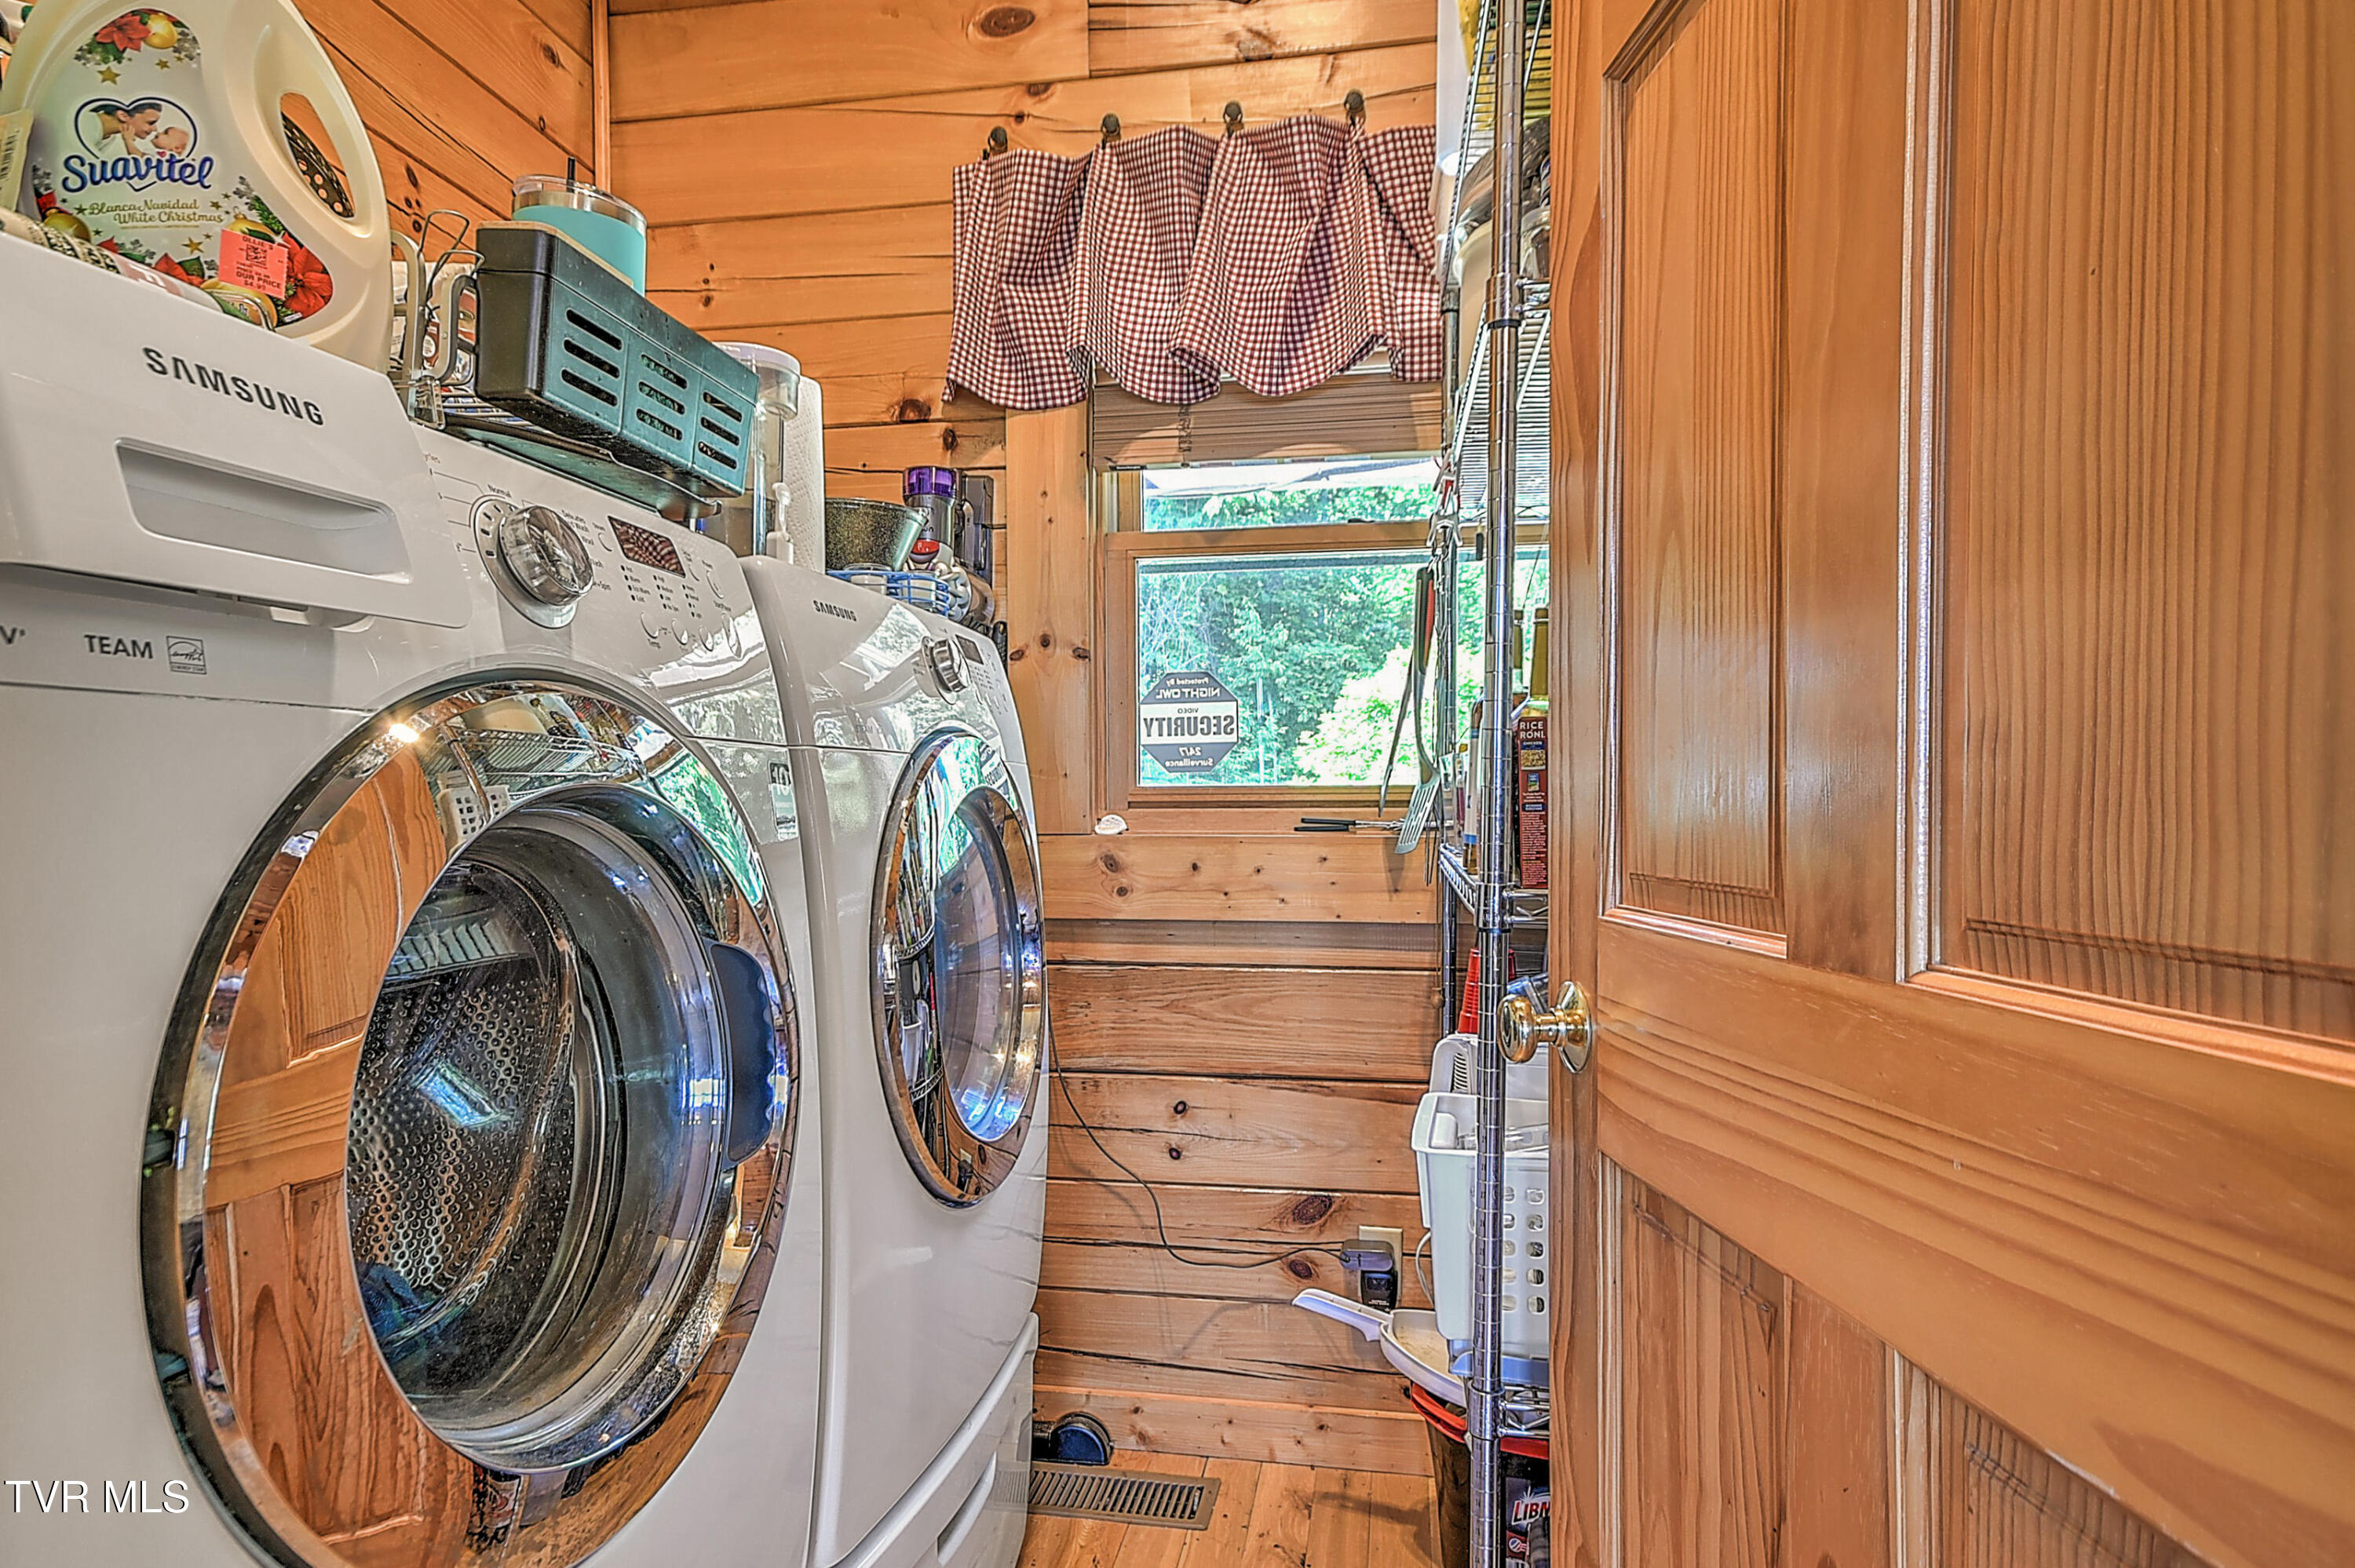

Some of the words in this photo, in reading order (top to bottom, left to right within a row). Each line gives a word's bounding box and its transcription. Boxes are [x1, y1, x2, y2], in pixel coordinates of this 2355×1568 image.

[62, 153, 214, 193] Suavitel
[89, 202, 137, 215] Blanca
[138, 198, 200, 213] Navidad
[115, 212, 156, 224] White
[158, 210, 225, 224] Christmas
[236, 271, 254, 281] OUR
[257, 276, 281, 290] PRICE
[142, 346, 324, 426] SAMSUNG
[812, 600, 857, 622] SAMSUNG
[84, 634, 154, 659] TEAM
[1520, 721, 1544, 730] RICE
